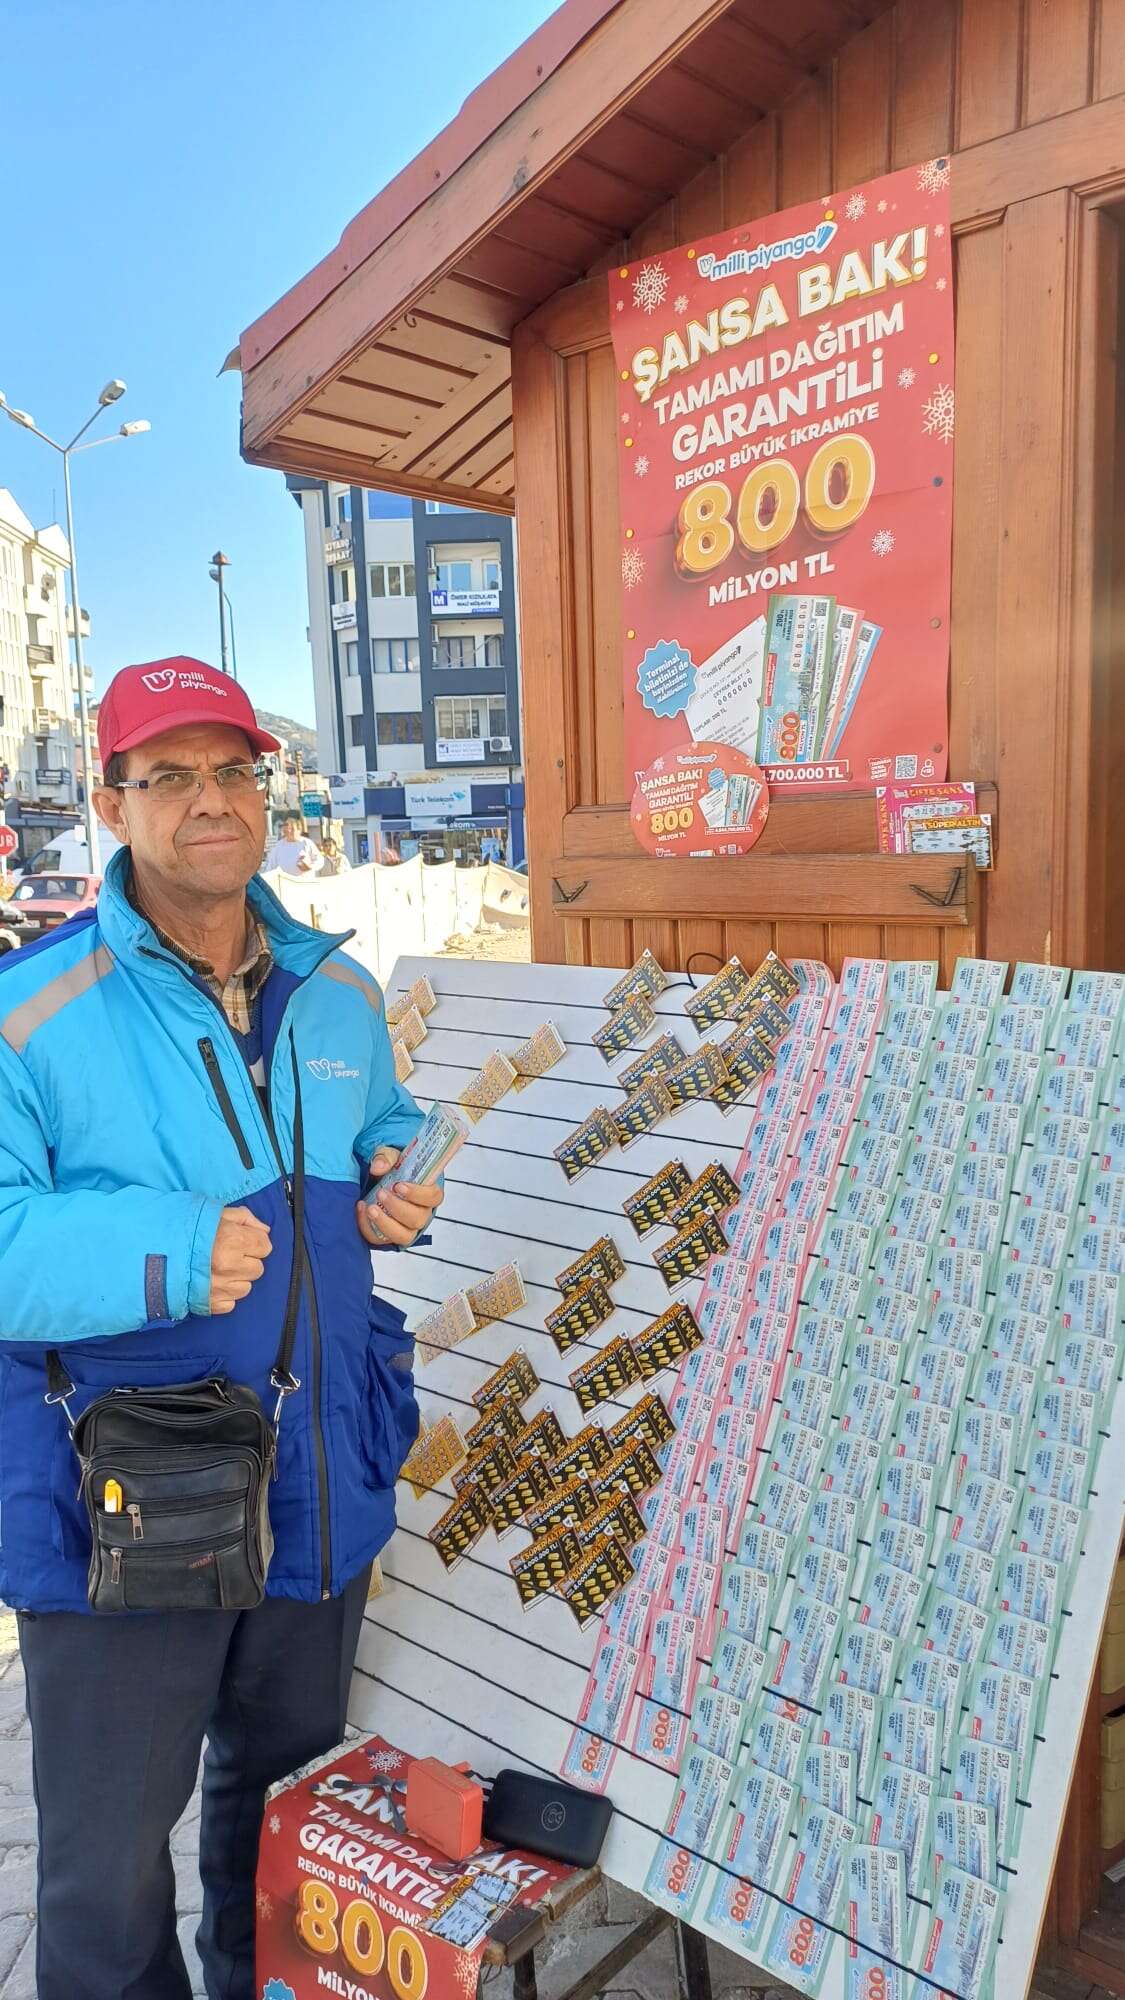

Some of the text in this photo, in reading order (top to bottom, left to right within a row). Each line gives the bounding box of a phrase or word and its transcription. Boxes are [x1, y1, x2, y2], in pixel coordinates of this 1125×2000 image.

[713, 234, 816, 278] milli piyango
[632, 225, 929, 402] ŞANSA BAK!
[654, 302, 905, 425] TAMAMI DAĞITIM
[671, 348, 884, 461] GARANTİLİ
[674, 402, 880, 491] REKOR BÜYÜK İKRAMİYE
[675, 432, 876, 573] 800
[708, 551, 835, 607] MİLYON TL
[178, 672, 205, 681] milli
[180, 680, 228, 697] piyango
[641, 774, 677, 793] ŞANSA
[826, 766, 843, 779] TL
[651, 807, 694, 834] 800
[308, 1800, 403, 1852] TAMAMI
[297, 1855, 336, 1884] REKOR
[338, 1873, 377, 1904] BÜYÜK
[298, 1822, 447, 1911] GARANTİL
[667, 1850, 690, 1893] 800
[296, 1879, 429, 2000] 800
[789, 1918, 815, 1967] 800
